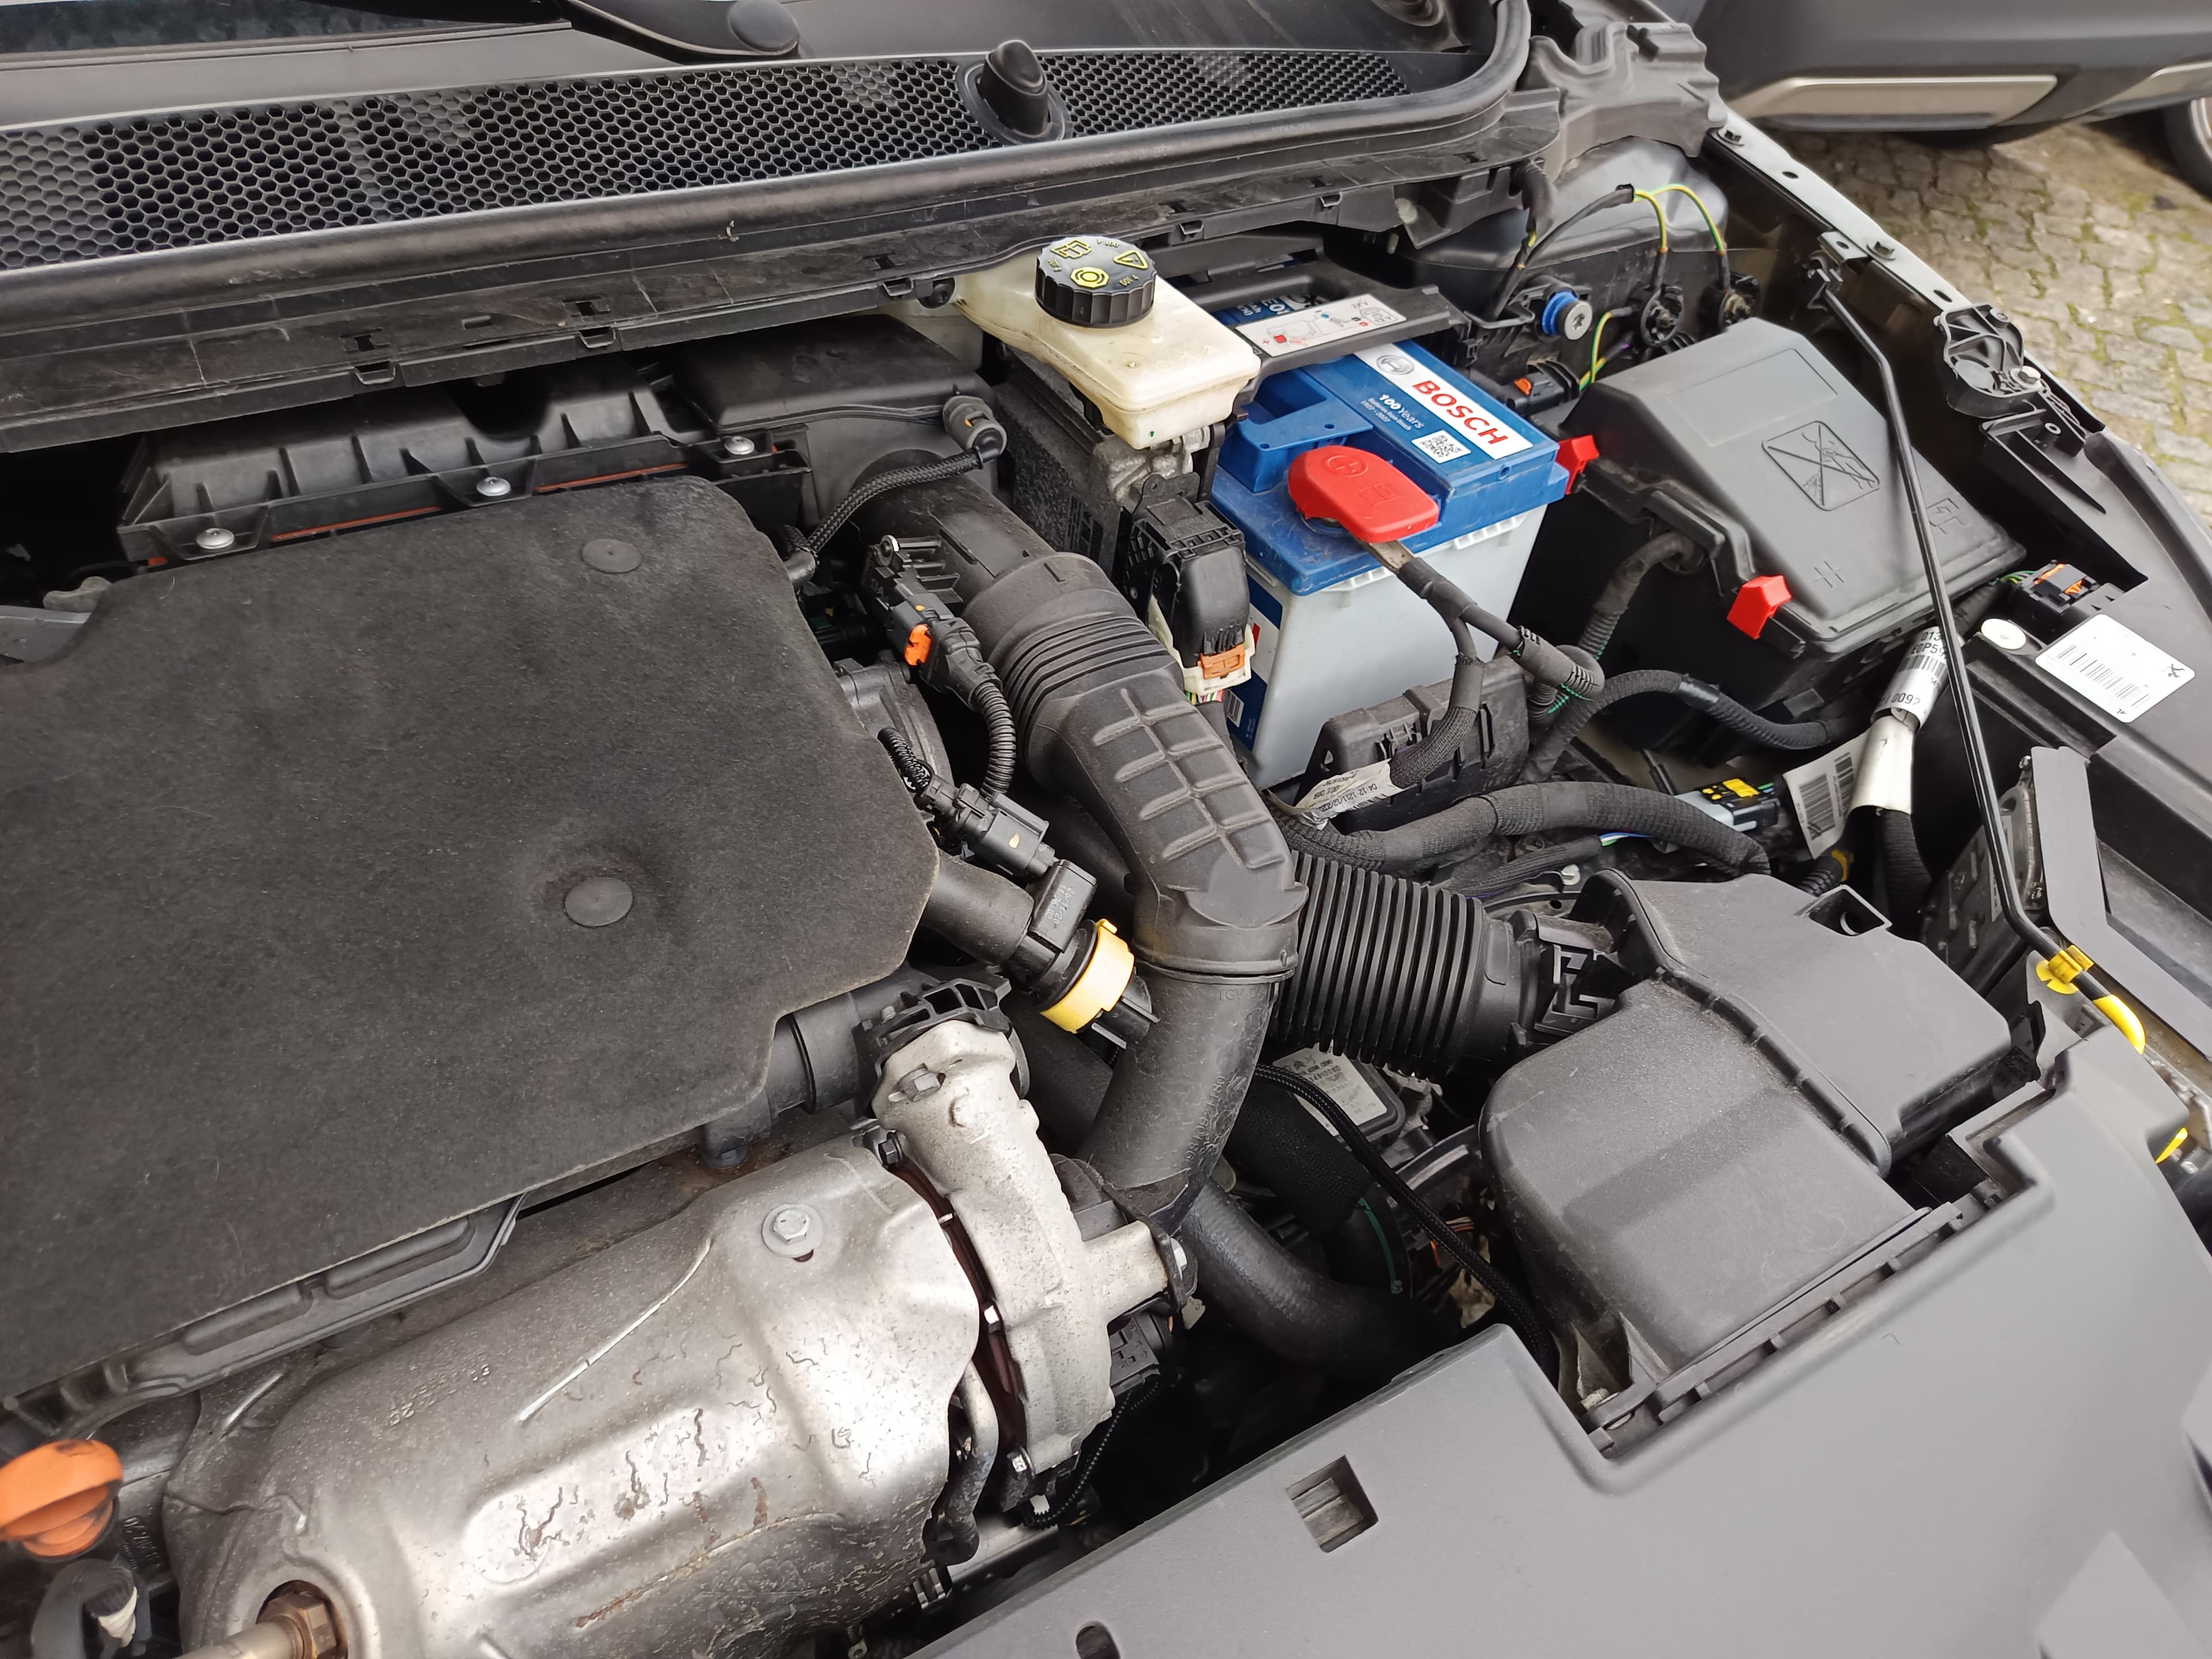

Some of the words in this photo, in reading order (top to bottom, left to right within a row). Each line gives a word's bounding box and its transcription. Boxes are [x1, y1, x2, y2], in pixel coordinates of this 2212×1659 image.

[1379, 394, 1402, 410] 100
[1397, 407, 1425, 429] Years
[1411, 380, 1509, 445] BOSCH
